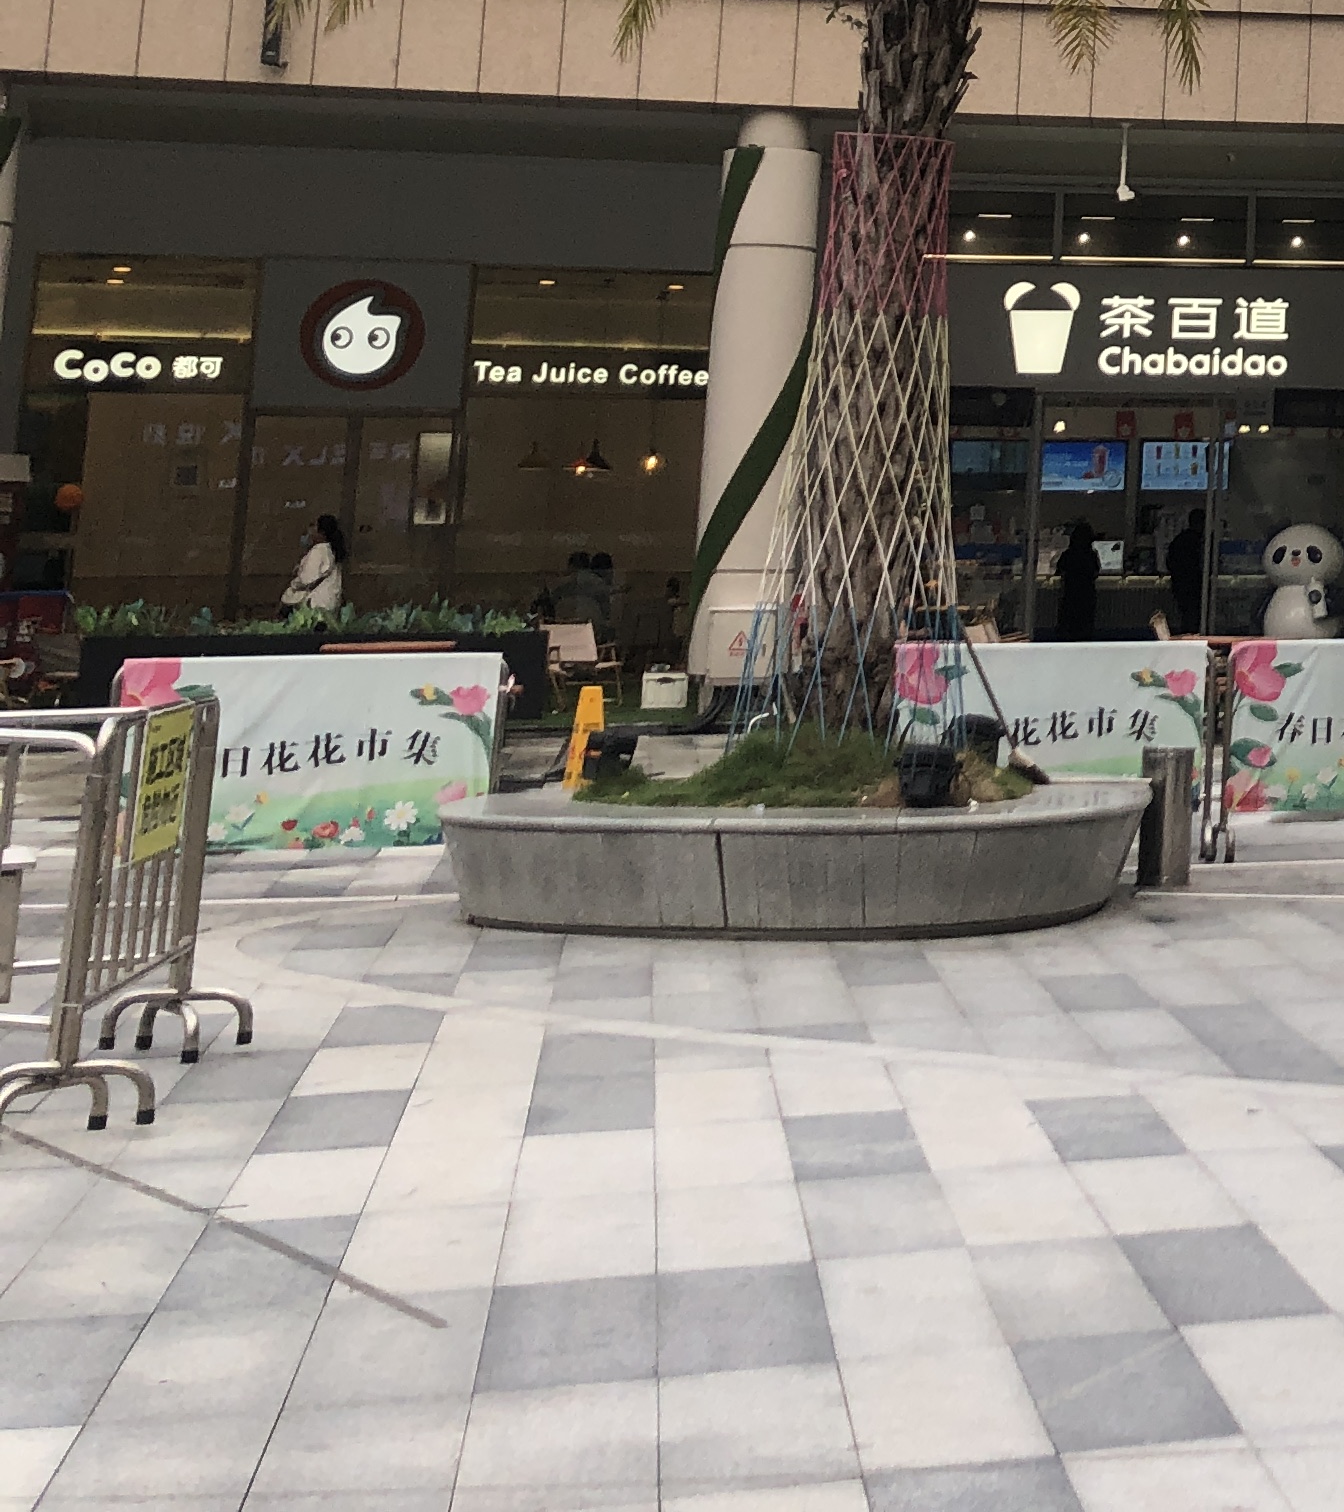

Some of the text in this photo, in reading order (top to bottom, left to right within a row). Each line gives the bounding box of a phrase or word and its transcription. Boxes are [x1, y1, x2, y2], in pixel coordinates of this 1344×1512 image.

[1099, 295, 1289, 340] 茶百道
[54, 349, 224, 382] CoCo 都可
[473, 360, 709, 385] Tea Juice Coffee
[1098, 346, 1288, 376] Chabaidao
